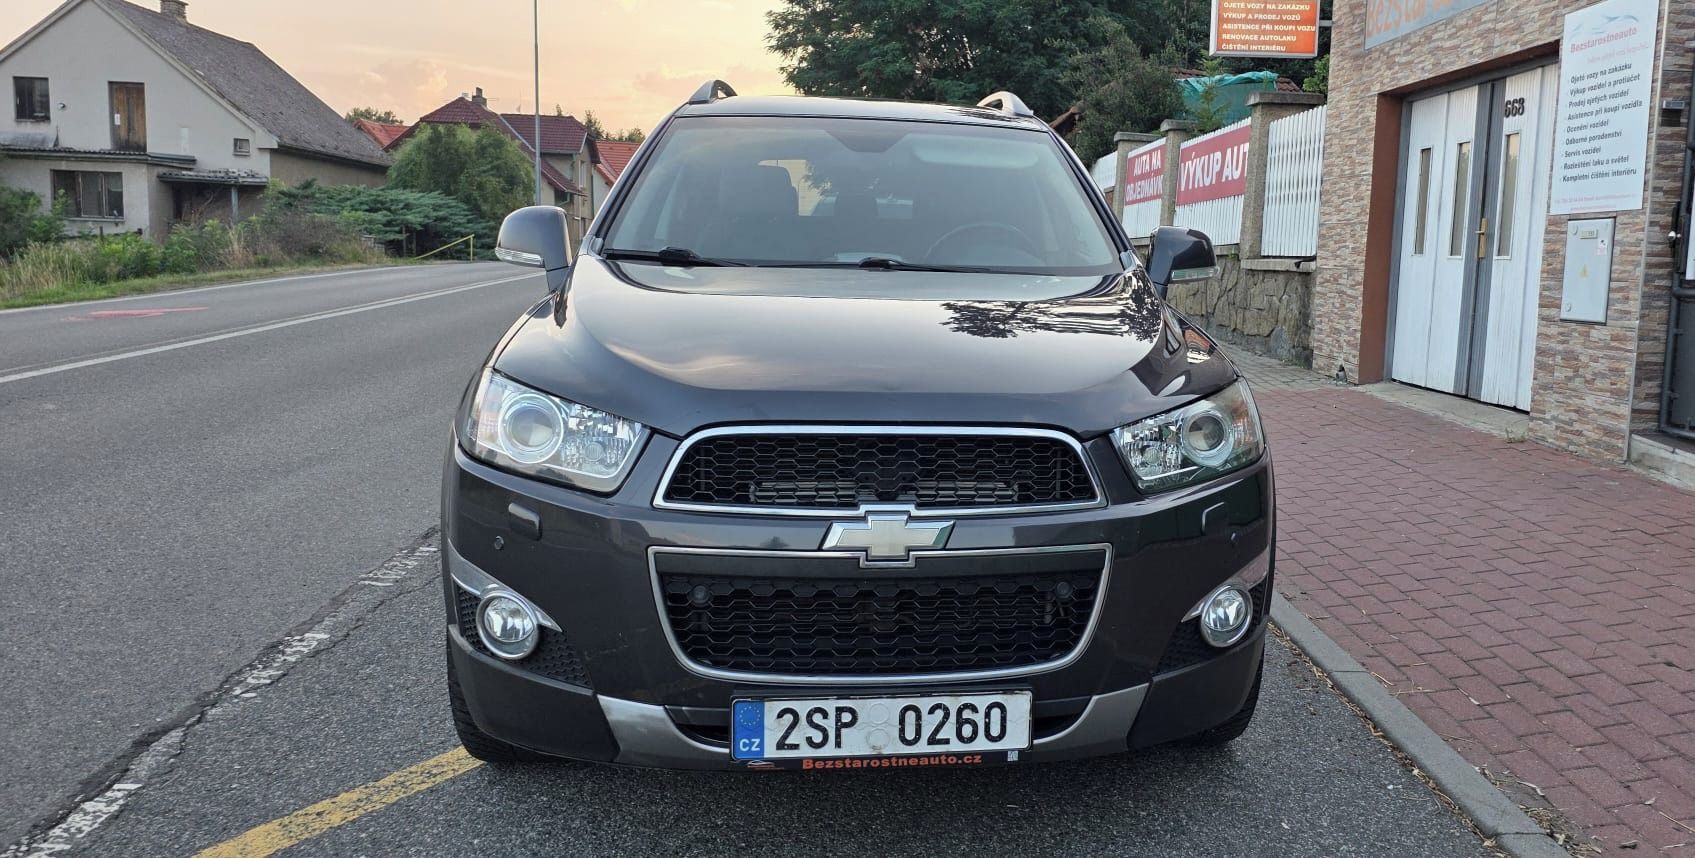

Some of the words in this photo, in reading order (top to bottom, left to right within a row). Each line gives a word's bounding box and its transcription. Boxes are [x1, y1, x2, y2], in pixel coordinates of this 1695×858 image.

[1221, 43, 1249, 51] ČIŠTĚNÍ
[1259, 34, 1297, 42] AUTOLAKU
[1570, 26, 1638, 54] Bezstarostneauto
[1570, 73, 1585, 84] Ojeté
[1586, 71, 1599, 80] vozy
[1599, 69, 1607, 77] na
[1607, 63, 1633, 75] zakázku
[1570, 86, 1586, 97] Výkup
[1587, 80, 1607, 92] vozidel
[1612, 73, 1641, 88] protiúčet
[1504, 97, 1525, 118] 668
[1568, 99, 1586, 109] Prodej
[1586, 94, 1607, 106] ojetých
[1608, 88, 1630, 100] vozidel
[1567, 109, 1594, 121] Asistence
[1594, 106, 1603, 117] při
[1603, 103, 1620, 115] koupi
[1621, 100, 1643, 110] vozidla
[1565, 135, 1588, 145] Odborné
[1588, 129, 1622, 144] poradenství
[1566, 124, 1589, 134] Ocenění
[1589, 120, 1609, 129] vozidel
[1564, 148, 1581, 158] Servis
[1581, 145, 1602, 155] vozidel
[1133, 153, 1150, 177] AUTA
[1151, 149, 1161, 171] NA
[1180, 151, 1222, 192] VÝKUP
[1221, 142, 1250, 183] AUT
[1562, 172, 1590, 183] Kompletní
[775, 706, 859, 751] 2SP
[898, 701, 1008, 747] 0260
[739, 738, 761, 752] CZ
[802, 754, 982, 770] Bezstarostneauto.cz
